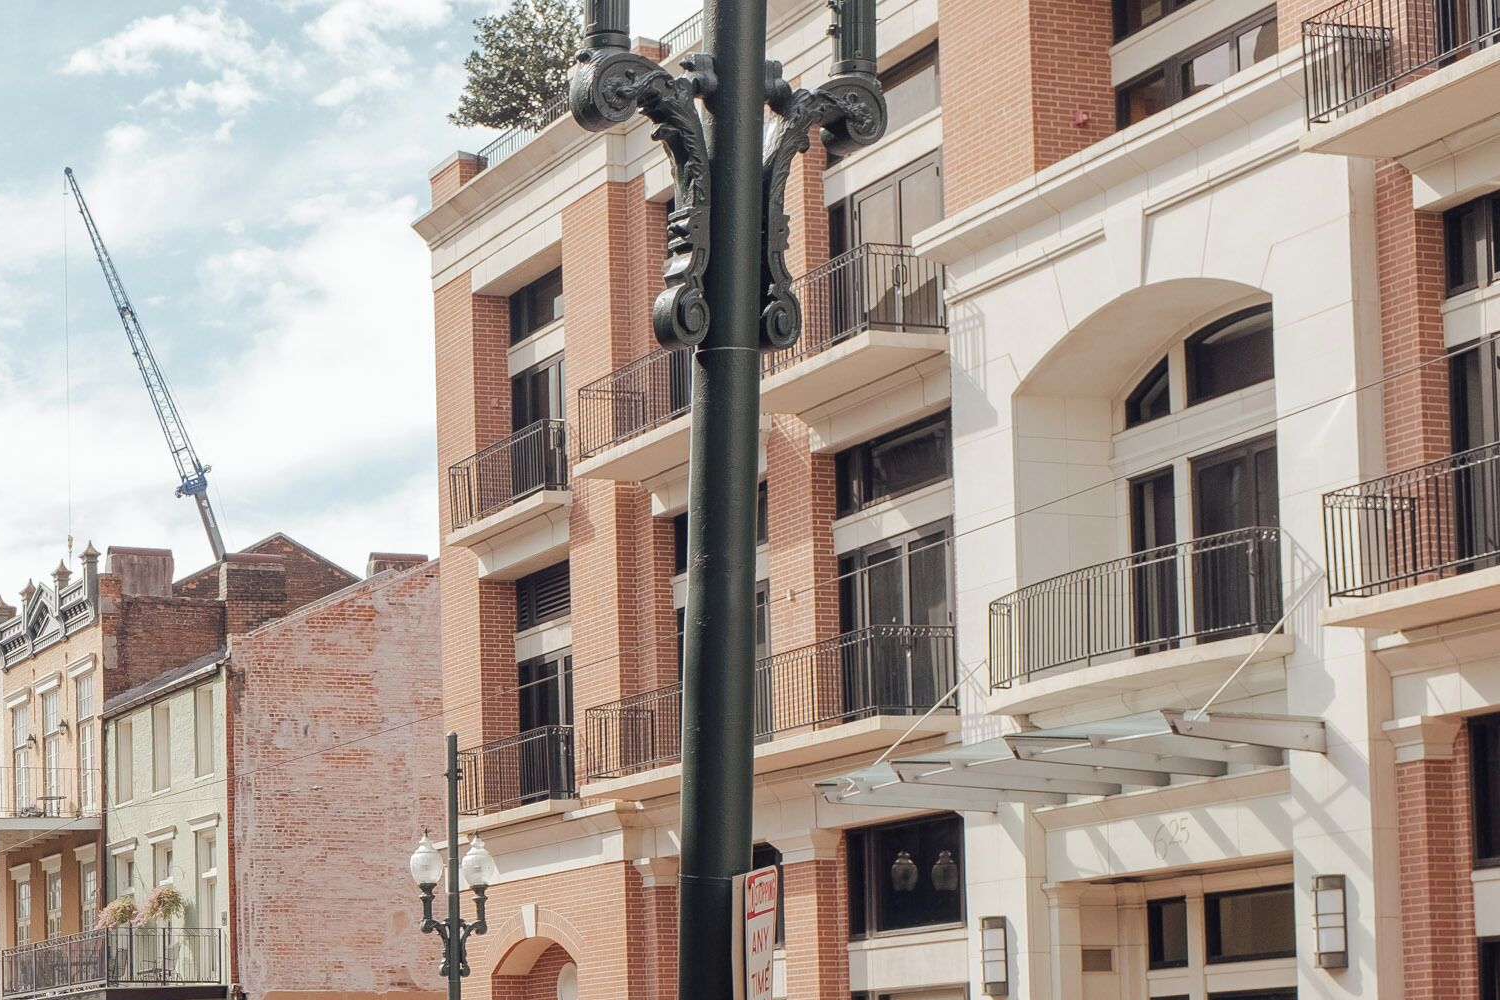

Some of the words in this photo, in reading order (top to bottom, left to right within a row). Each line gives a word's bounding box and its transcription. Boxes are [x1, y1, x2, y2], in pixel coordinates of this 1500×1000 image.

[1153, 817, 1190, 861] 625
[752, 926, 769, 957] ANY
[751, 964, 770, 998] TIME
